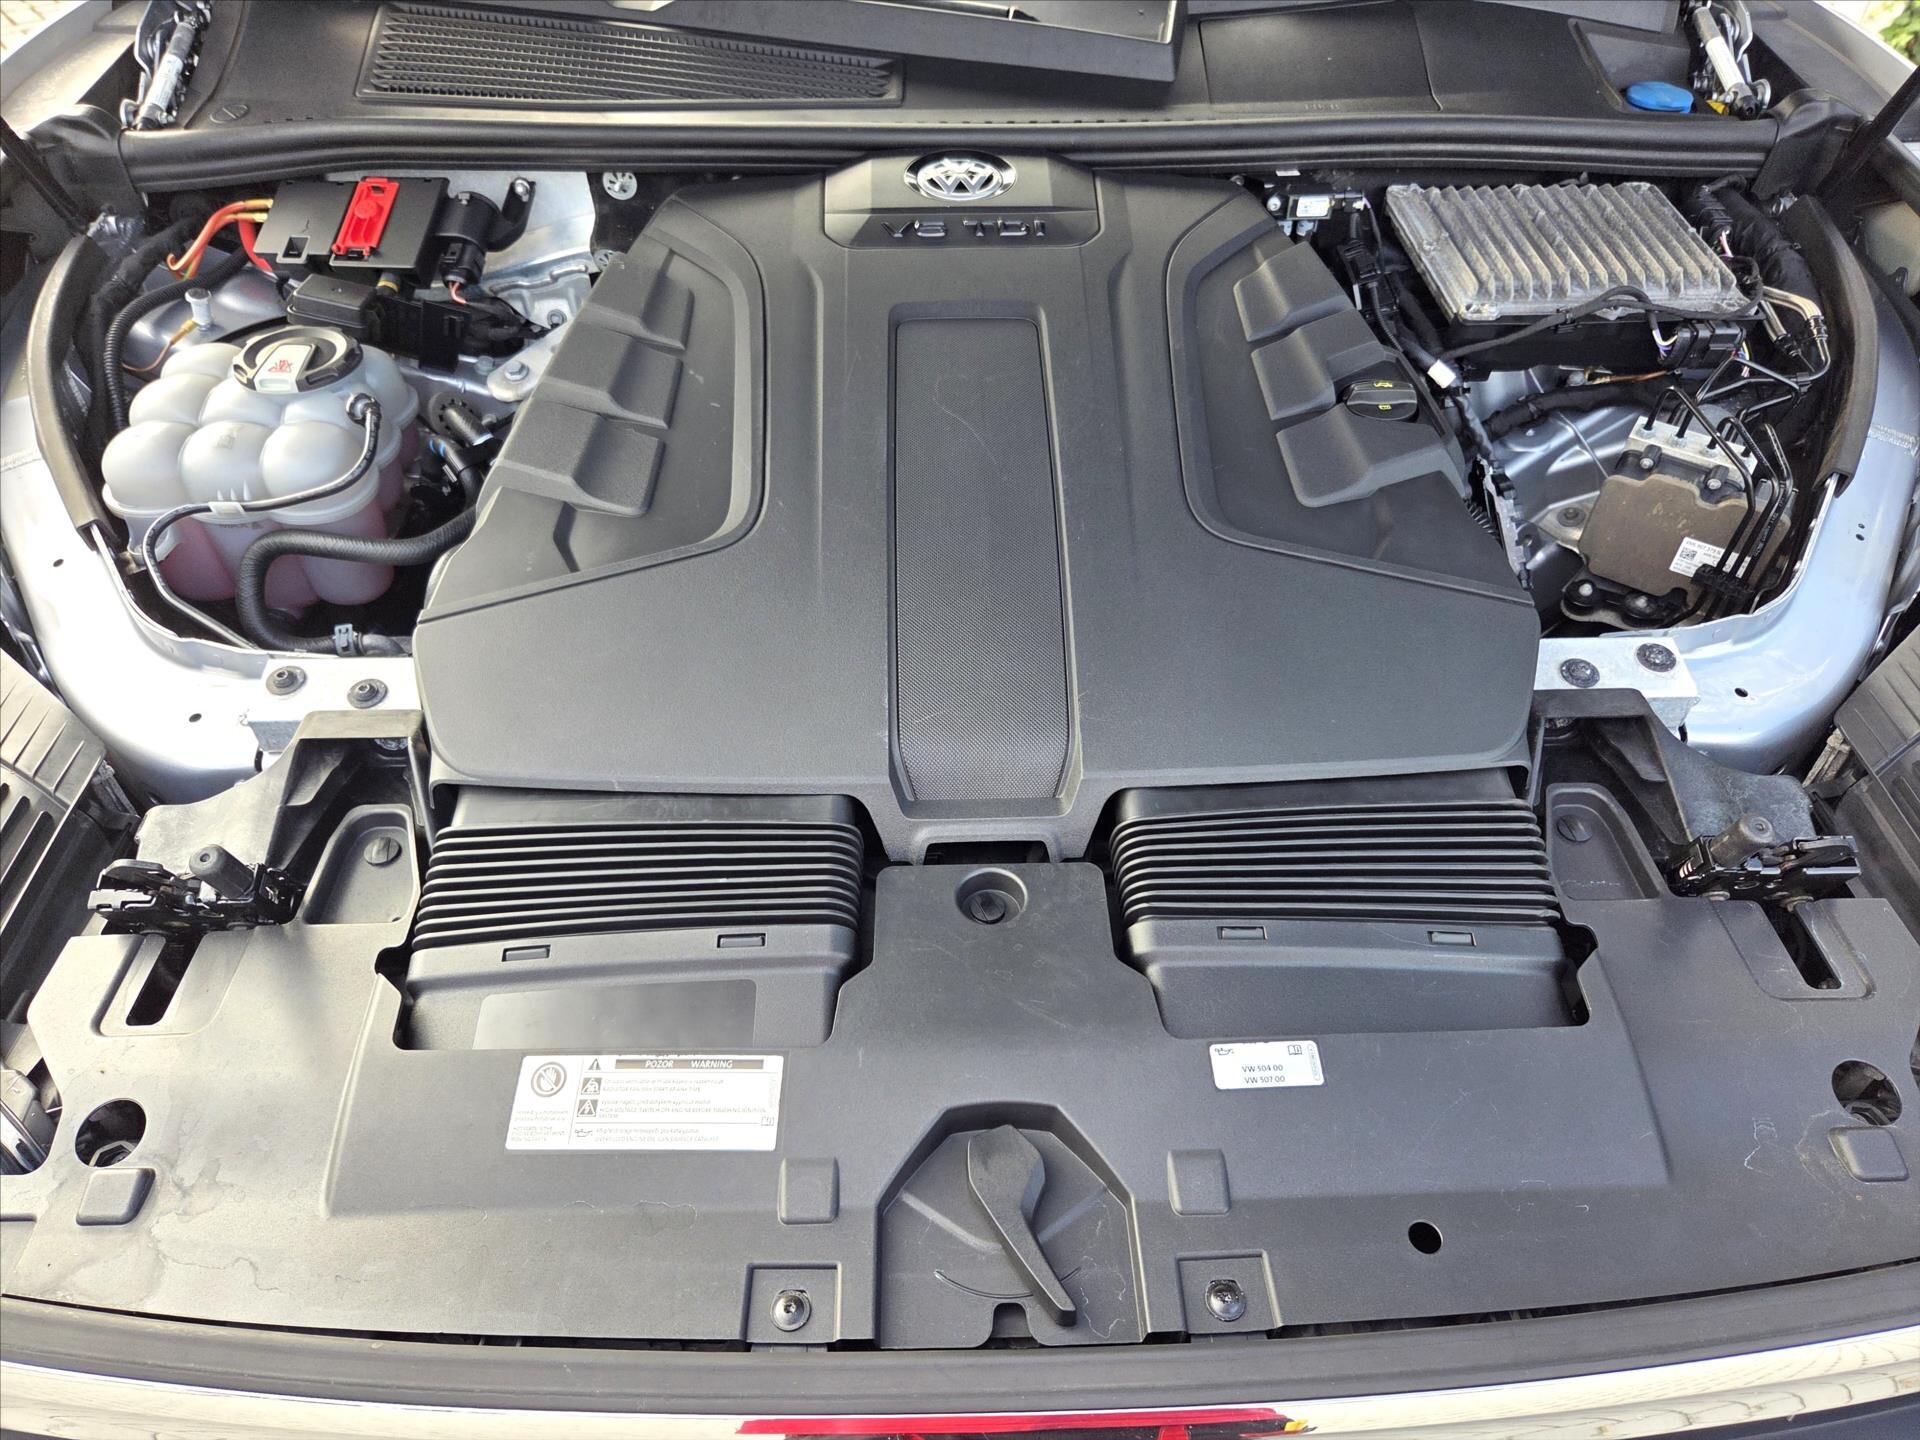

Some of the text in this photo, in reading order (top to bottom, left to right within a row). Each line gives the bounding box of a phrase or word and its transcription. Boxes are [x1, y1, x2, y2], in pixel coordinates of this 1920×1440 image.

[962, 214, 1047, 238] TDI
[644, 1059, 733, 1069] POZOR WARNING
[1241, 1063, 1284, 1073] VW 504 00
[1244, 1074, 1286, 1084] VW 507 00
